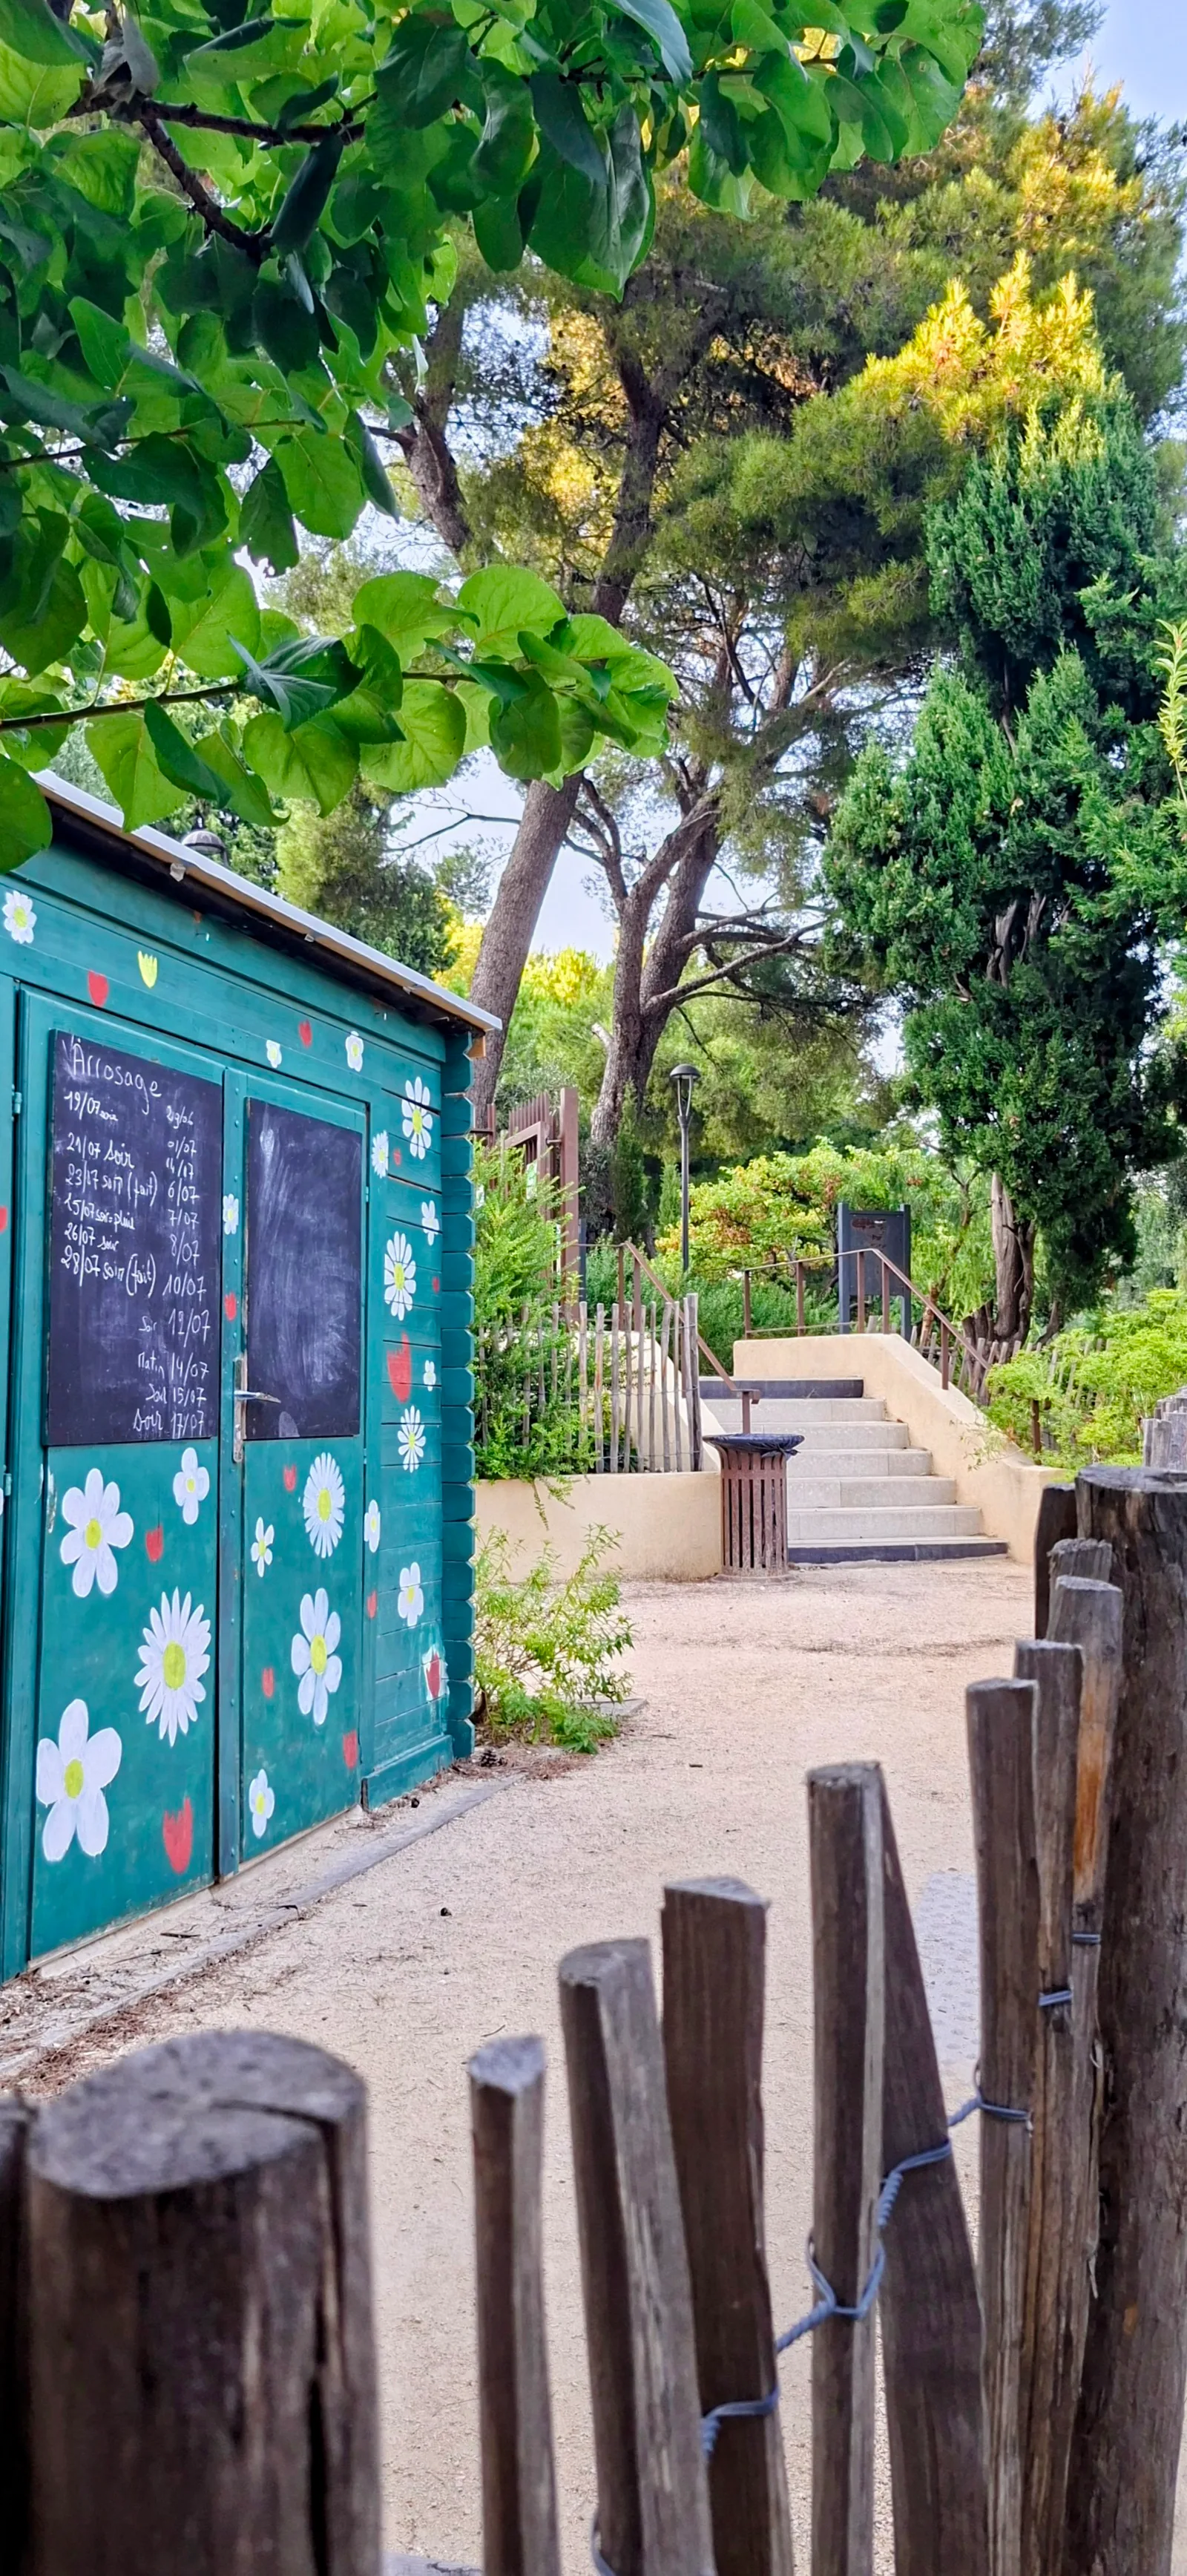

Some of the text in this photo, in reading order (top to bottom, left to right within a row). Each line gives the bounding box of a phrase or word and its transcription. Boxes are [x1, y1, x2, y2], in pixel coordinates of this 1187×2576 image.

[64, 1091, 101, 1120] 19/07
[67, 1132, 101, 1159] 21/07
[167, 1135, 197, 1158] 01/07
[168, 1178, 200, 1207] 6/07
[64, 1222, 96, 1246] 26/07
[168, 1209, 200, 1230] 7/07
[169, 1231, 200, 1267] 8/07
[60, 1245, 101, 1287] 28/07
[162, 1272, 207, 1302] 10/07
[168, 1308, 211, 1348] 12/07
[171, 1352, 209, 1386] 14/07
[173, 1387, 207, 1407] 15/07
[171, 1410, 205, 1439] 17/07
